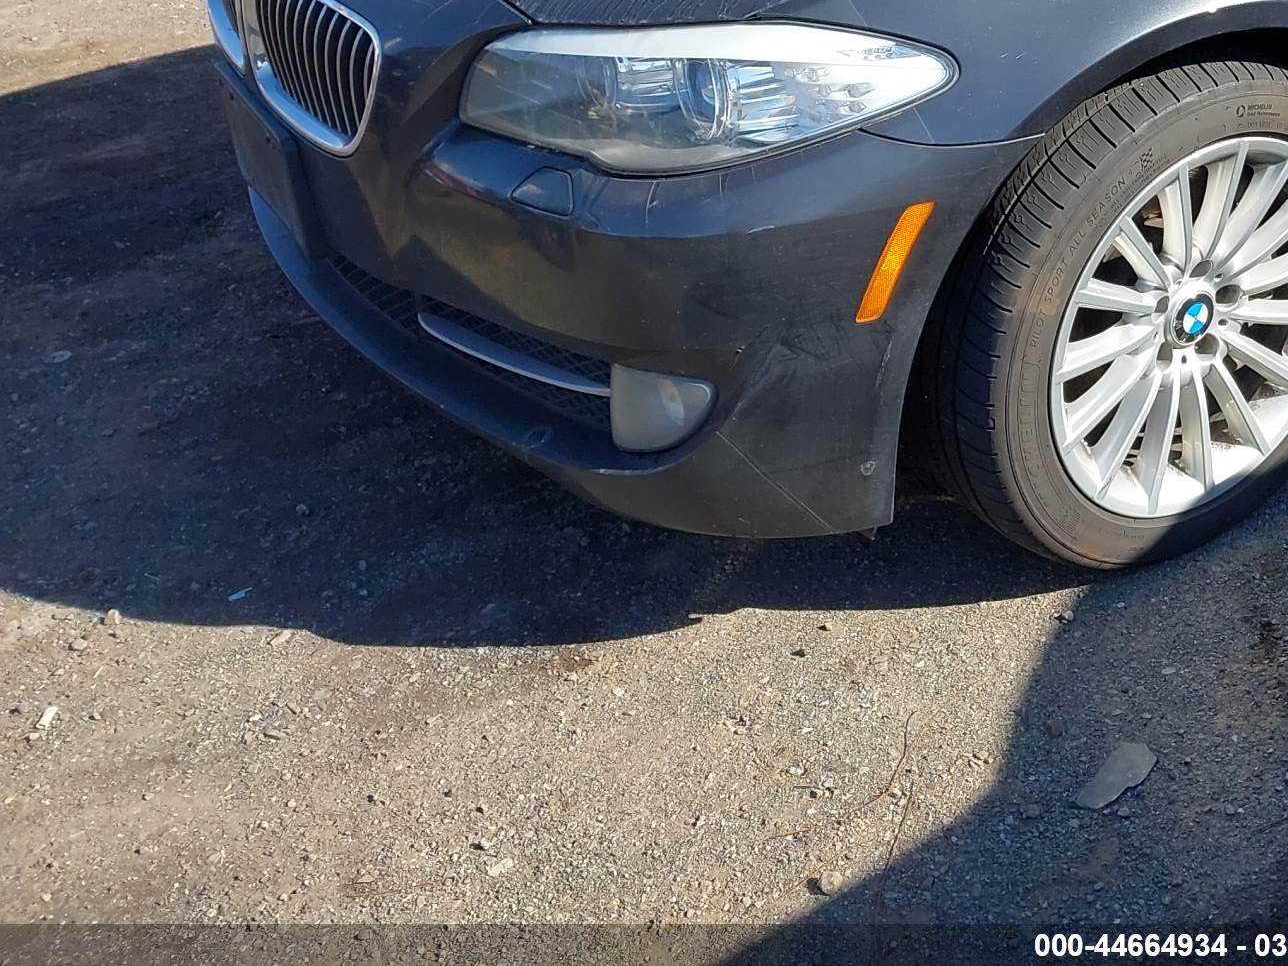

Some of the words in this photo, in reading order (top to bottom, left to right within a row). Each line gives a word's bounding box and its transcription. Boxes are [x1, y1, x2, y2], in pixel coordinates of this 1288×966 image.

[1044, 259, 1071, 307] SPORT
[1068, 230, 1086, 258] ALL
[1086, 176, 1128, 226] SEASON
